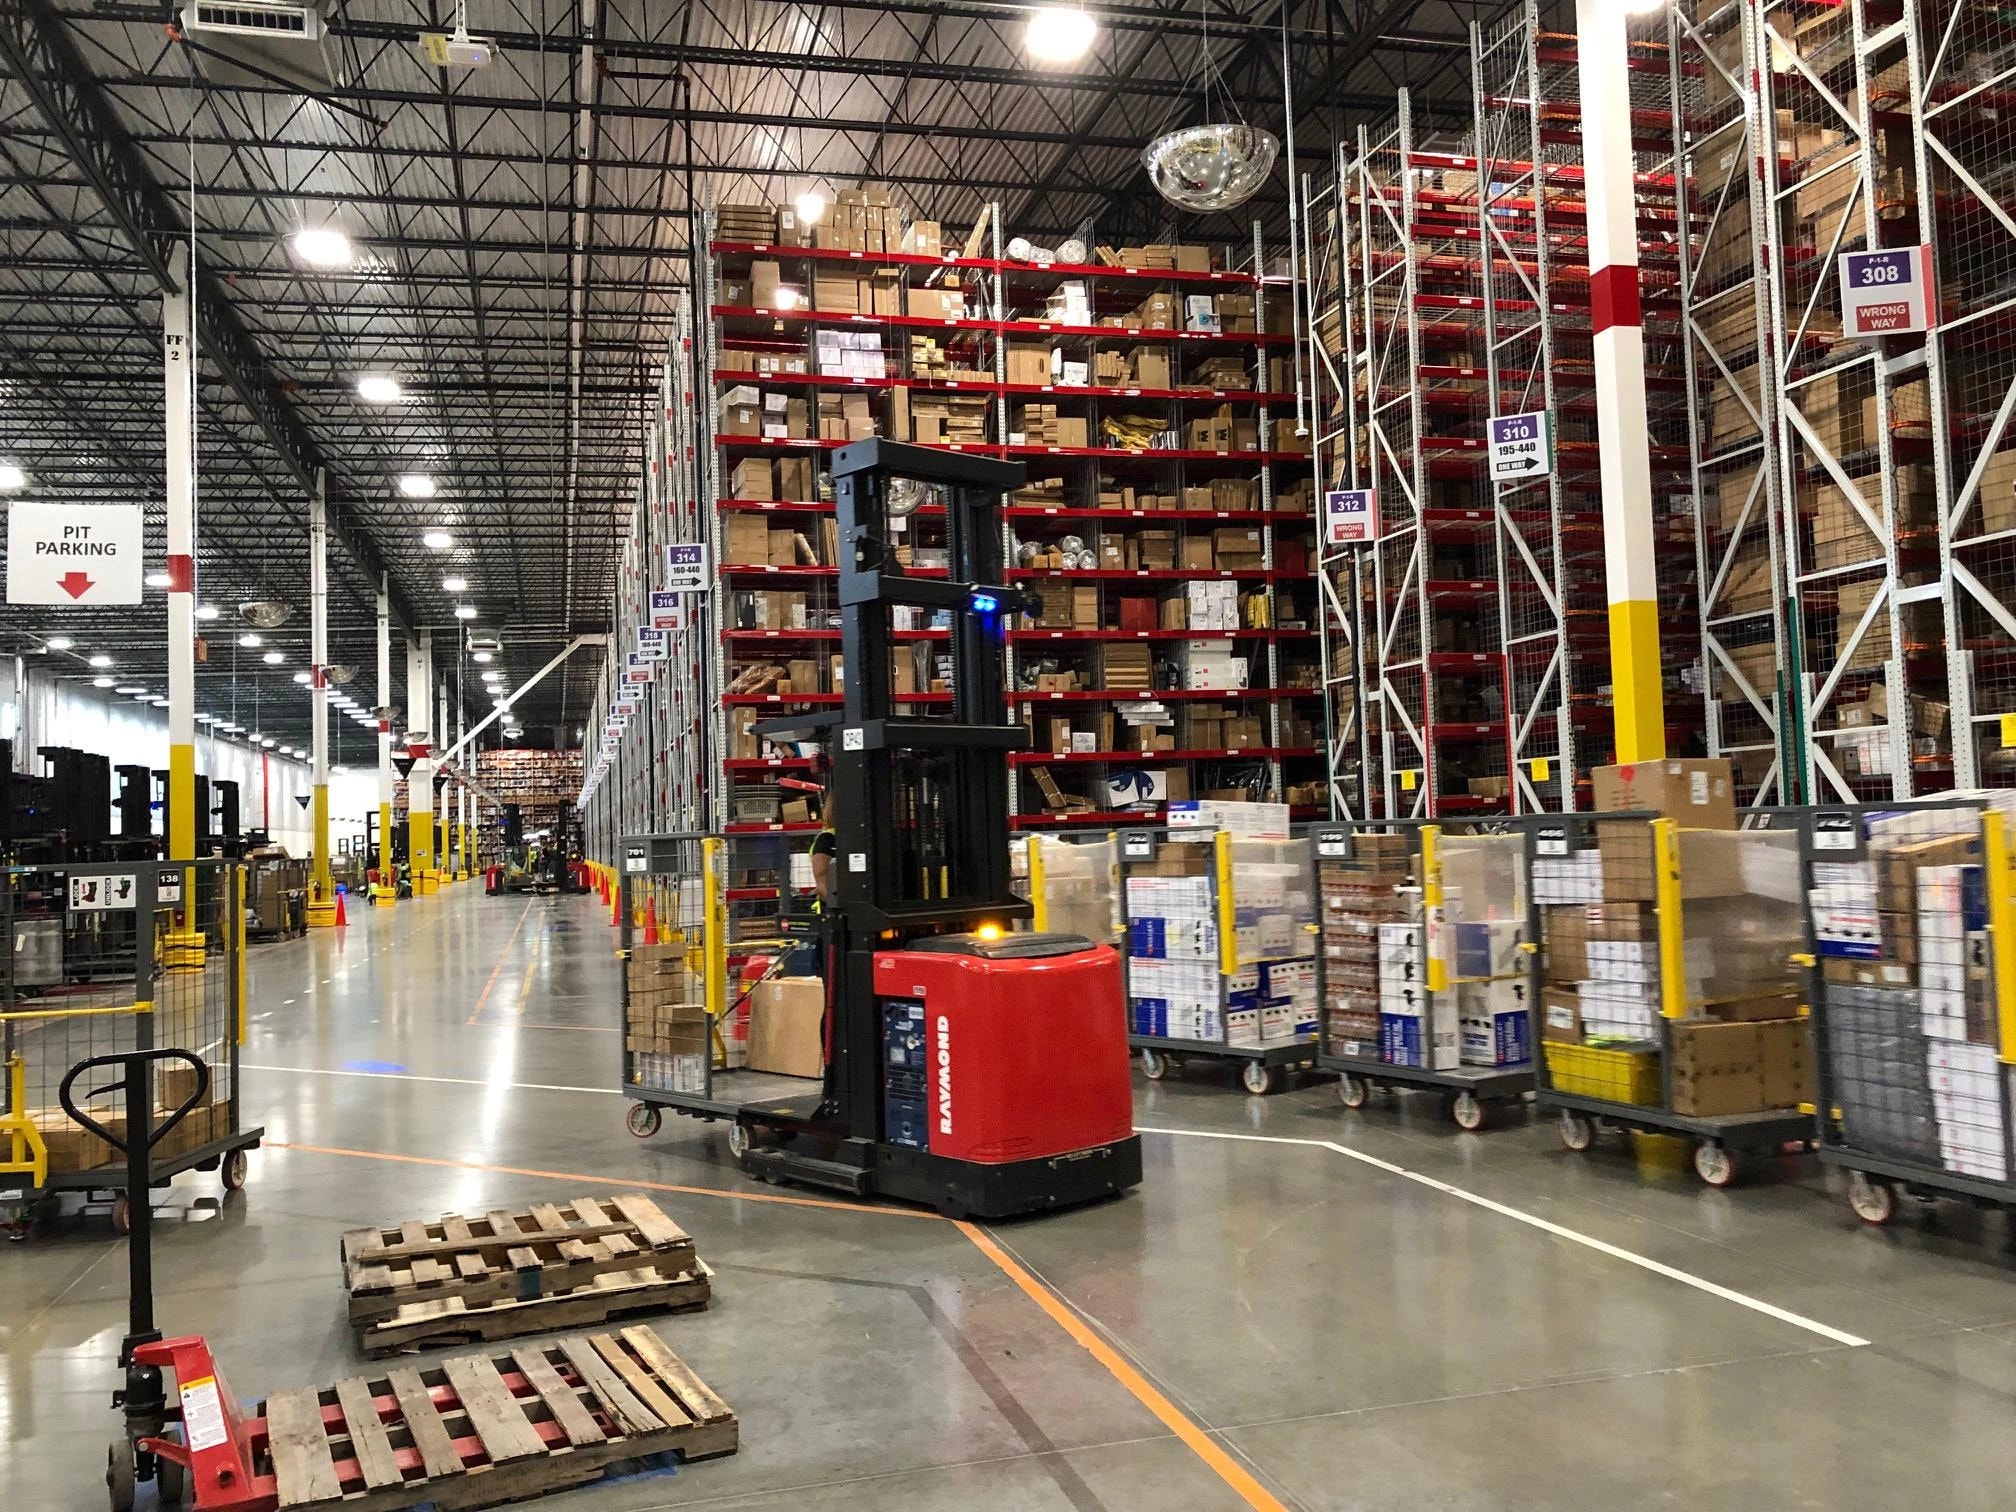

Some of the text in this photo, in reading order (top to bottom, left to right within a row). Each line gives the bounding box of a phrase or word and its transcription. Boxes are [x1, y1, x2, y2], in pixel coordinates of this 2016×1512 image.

[1869, 256, 1889, 265] P-1-R
[1861, 265, 1899, 284] 308
[1860, 304, 1906, 318] WRONG
[1871, 318, 1897, 329] WAY
[166, 334, 184, 345] FF
[171, 350, 180, 361] 2
[1503, 426, 1529, 440] 310
[1498, 442, 1536, 456] 195-440
[1498, 462, 1511, 471] ONE
[1337, 500, 1360, 511] 312
[64, 526, 91, 539] PIT
[1336, 524, 1363, 532] WRONG
[35, 541, 117, 556] PARKING
[676, 552, 696, 563] 314
[657, 598, 674, 607] 316
[627, 848, 644, 856] 701
[160, 874, 179, 883] 138
[937, 1015, 952, 1135] RAYMOND
